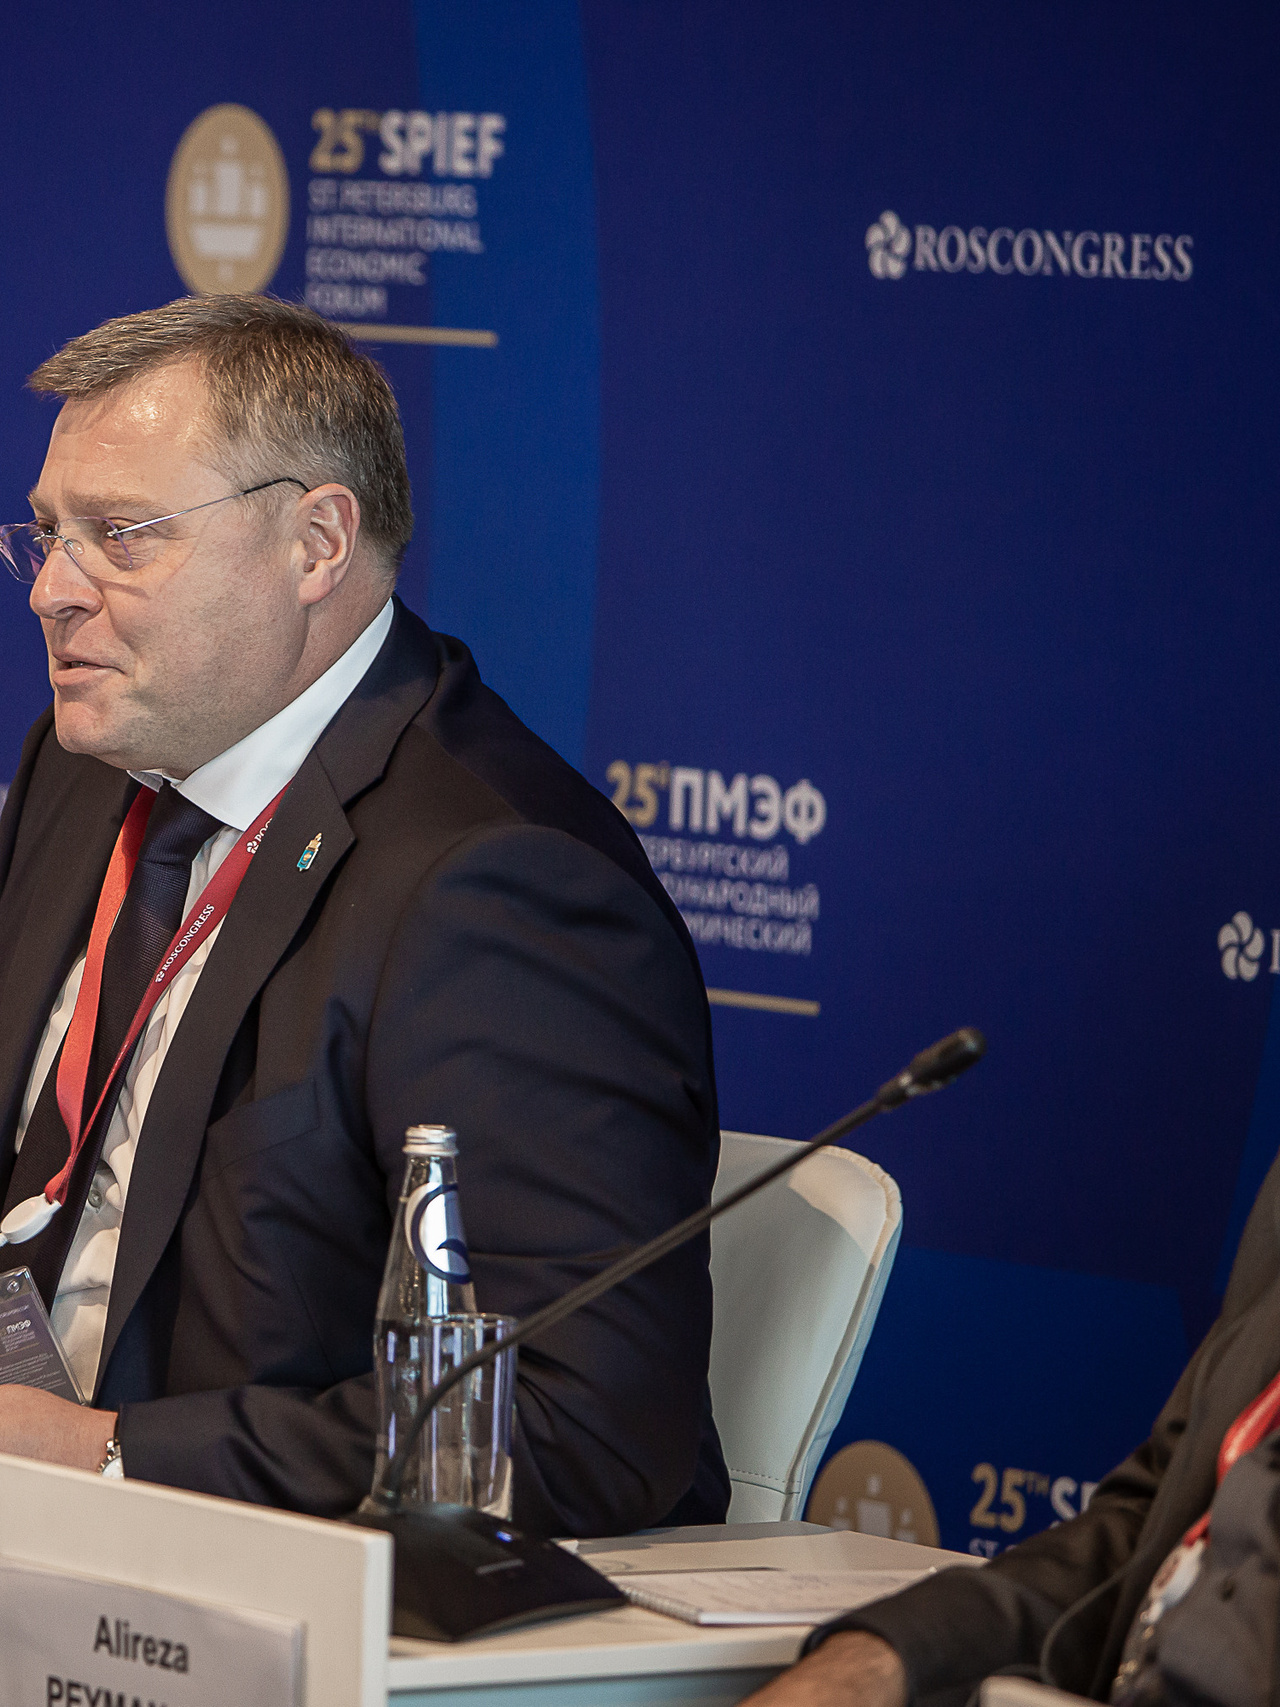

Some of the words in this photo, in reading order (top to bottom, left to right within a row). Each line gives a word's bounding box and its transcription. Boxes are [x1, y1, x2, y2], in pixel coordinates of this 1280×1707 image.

[379, 109, 507, 179] SPIEF
[913, 224, 1194, 282] ROSCONGRESS
[670, 766, 827, 845] ПМЭФ
[162, 903, 215, 972] ROSCONGRESS
[93, 1614, 190, 1674] Alireza
